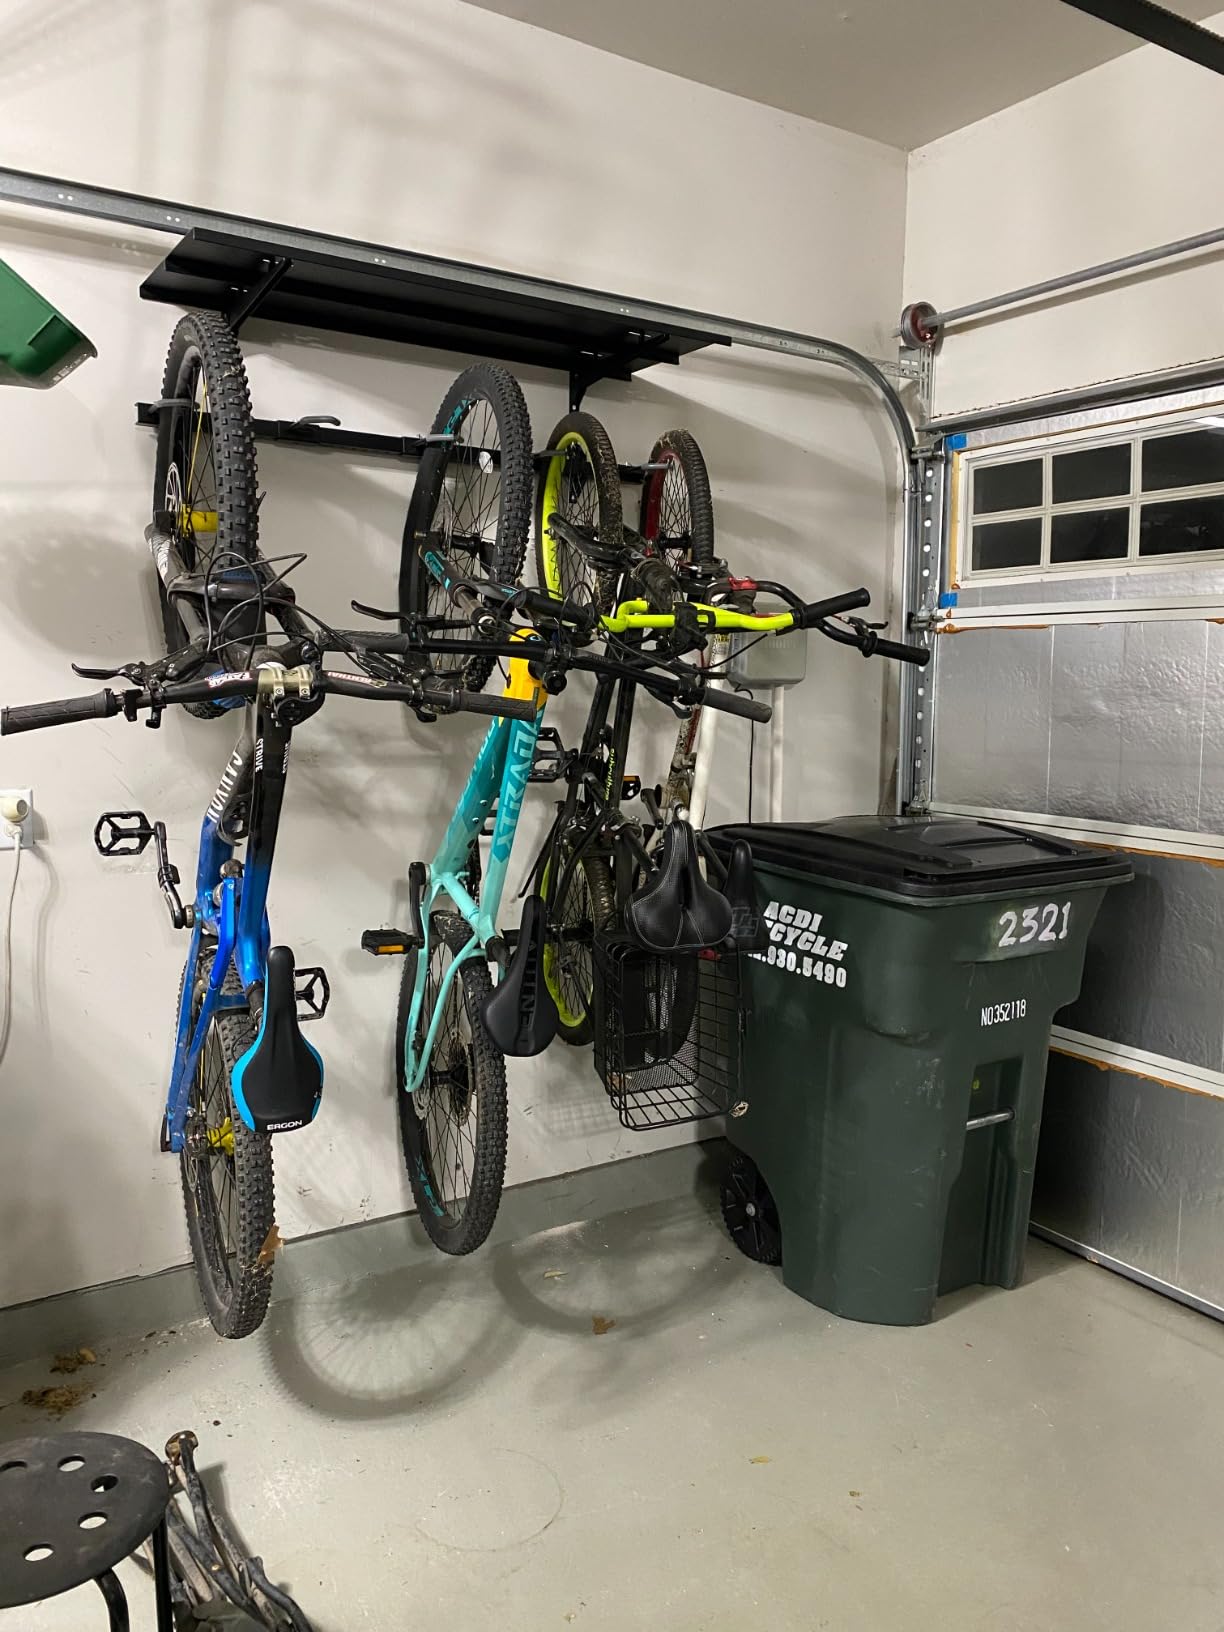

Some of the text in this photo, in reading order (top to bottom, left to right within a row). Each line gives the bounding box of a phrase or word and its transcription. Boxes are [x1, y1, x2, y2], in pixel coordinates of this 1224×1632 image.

[254, 737, 264, 773] STRIVE
[765, 919, 849, 961] CYCLE
[998, 901, 1071, 947] 2321
[980, 999, 1027, 1026] NO352118
[266, 1120, 303, 1131] ERGON
